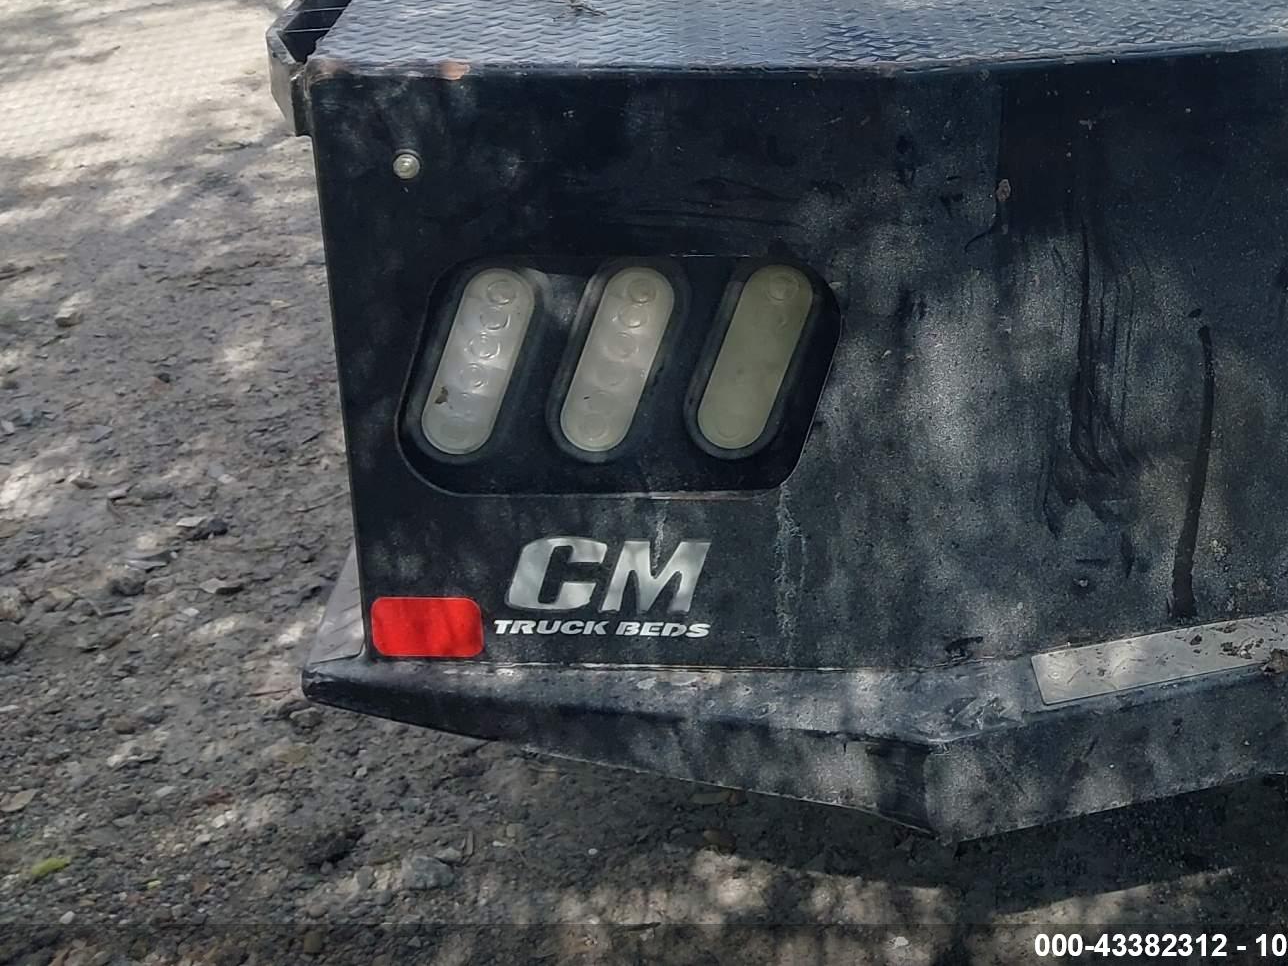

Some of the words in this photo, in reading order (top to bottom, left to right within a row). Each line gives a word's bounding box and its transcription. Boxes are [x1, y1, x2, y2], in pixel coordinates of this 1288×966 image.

[508, 536, 711, 612] CM
[494, 620, 609, 635] TRUCK
[615, 622, 711, 638] BEDS
